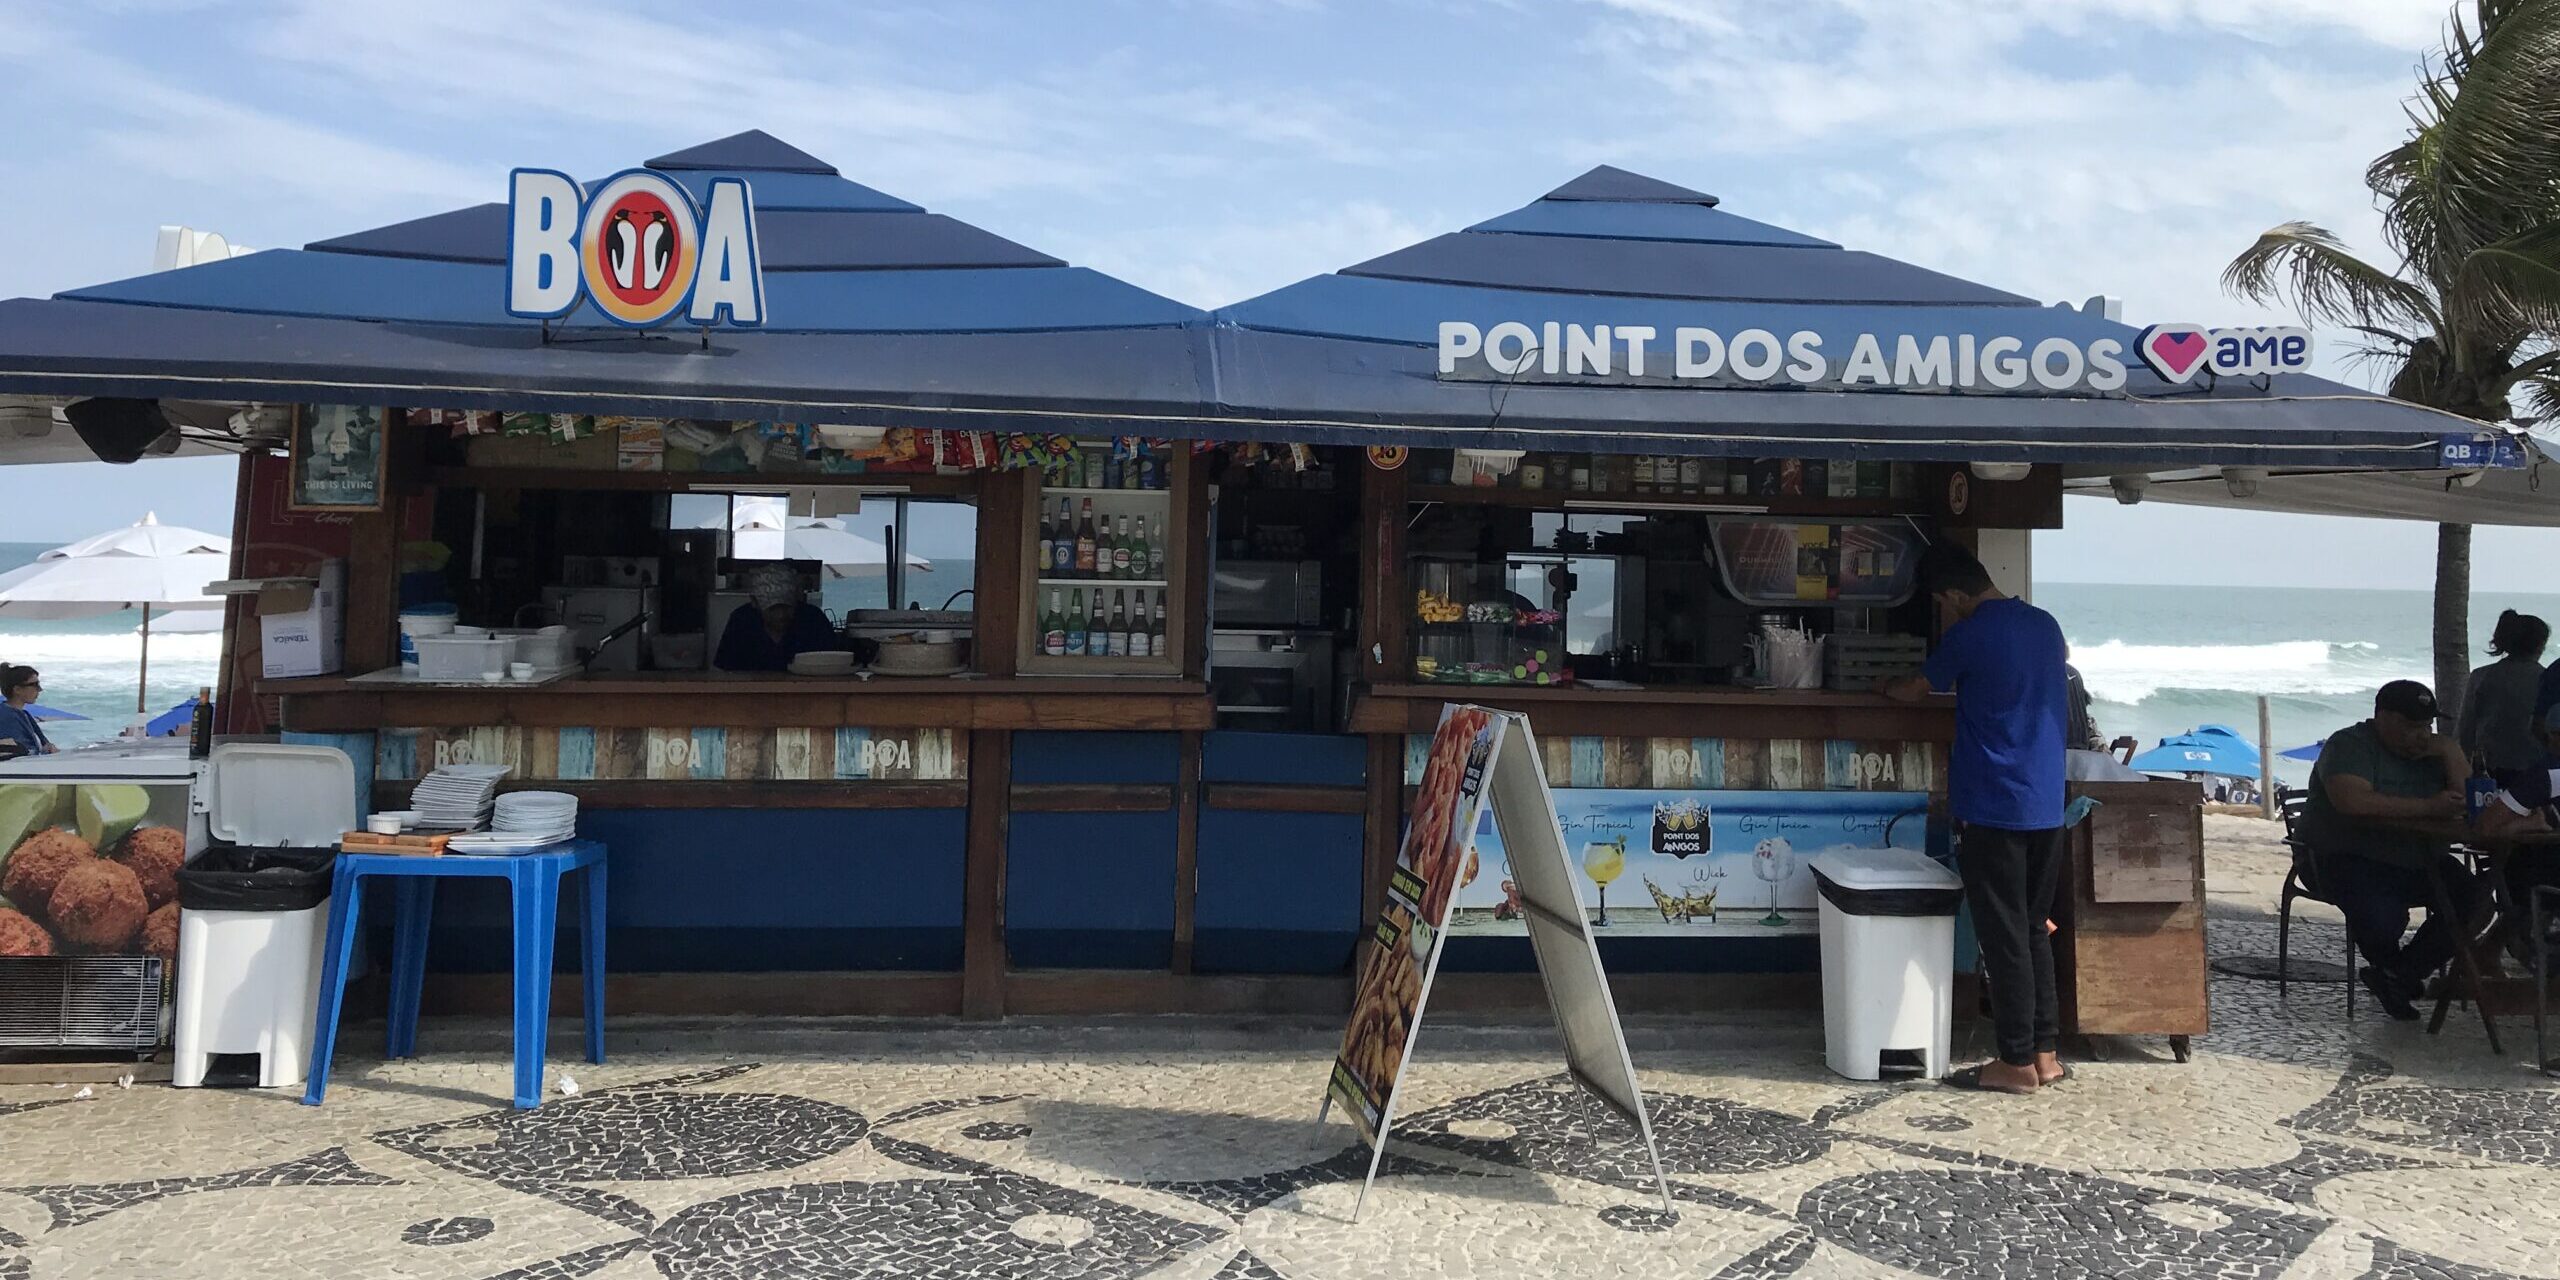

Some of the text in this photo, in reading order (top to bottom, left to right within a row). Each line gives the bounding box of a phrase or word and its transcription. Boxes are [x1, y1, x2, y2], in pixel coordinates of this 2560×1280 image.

[506, 167, 763, 327] BOA
[1438, 321, 2128, 391] POINT DOS AMIGOS
[2444, 444, 2471, 459] QB
[304, 480, 374, 490] THIS IS LIVING
[650, 738, 701, 768] BOA
[861, 738, 911, 770] BOA
[1652, 748, 1703, 778] BOA
[1849, 752, 1897, 783] BOA
[1557, 814, 1635, 835] Gin Tropical
[1739, 814, 1768, 835] Gin
